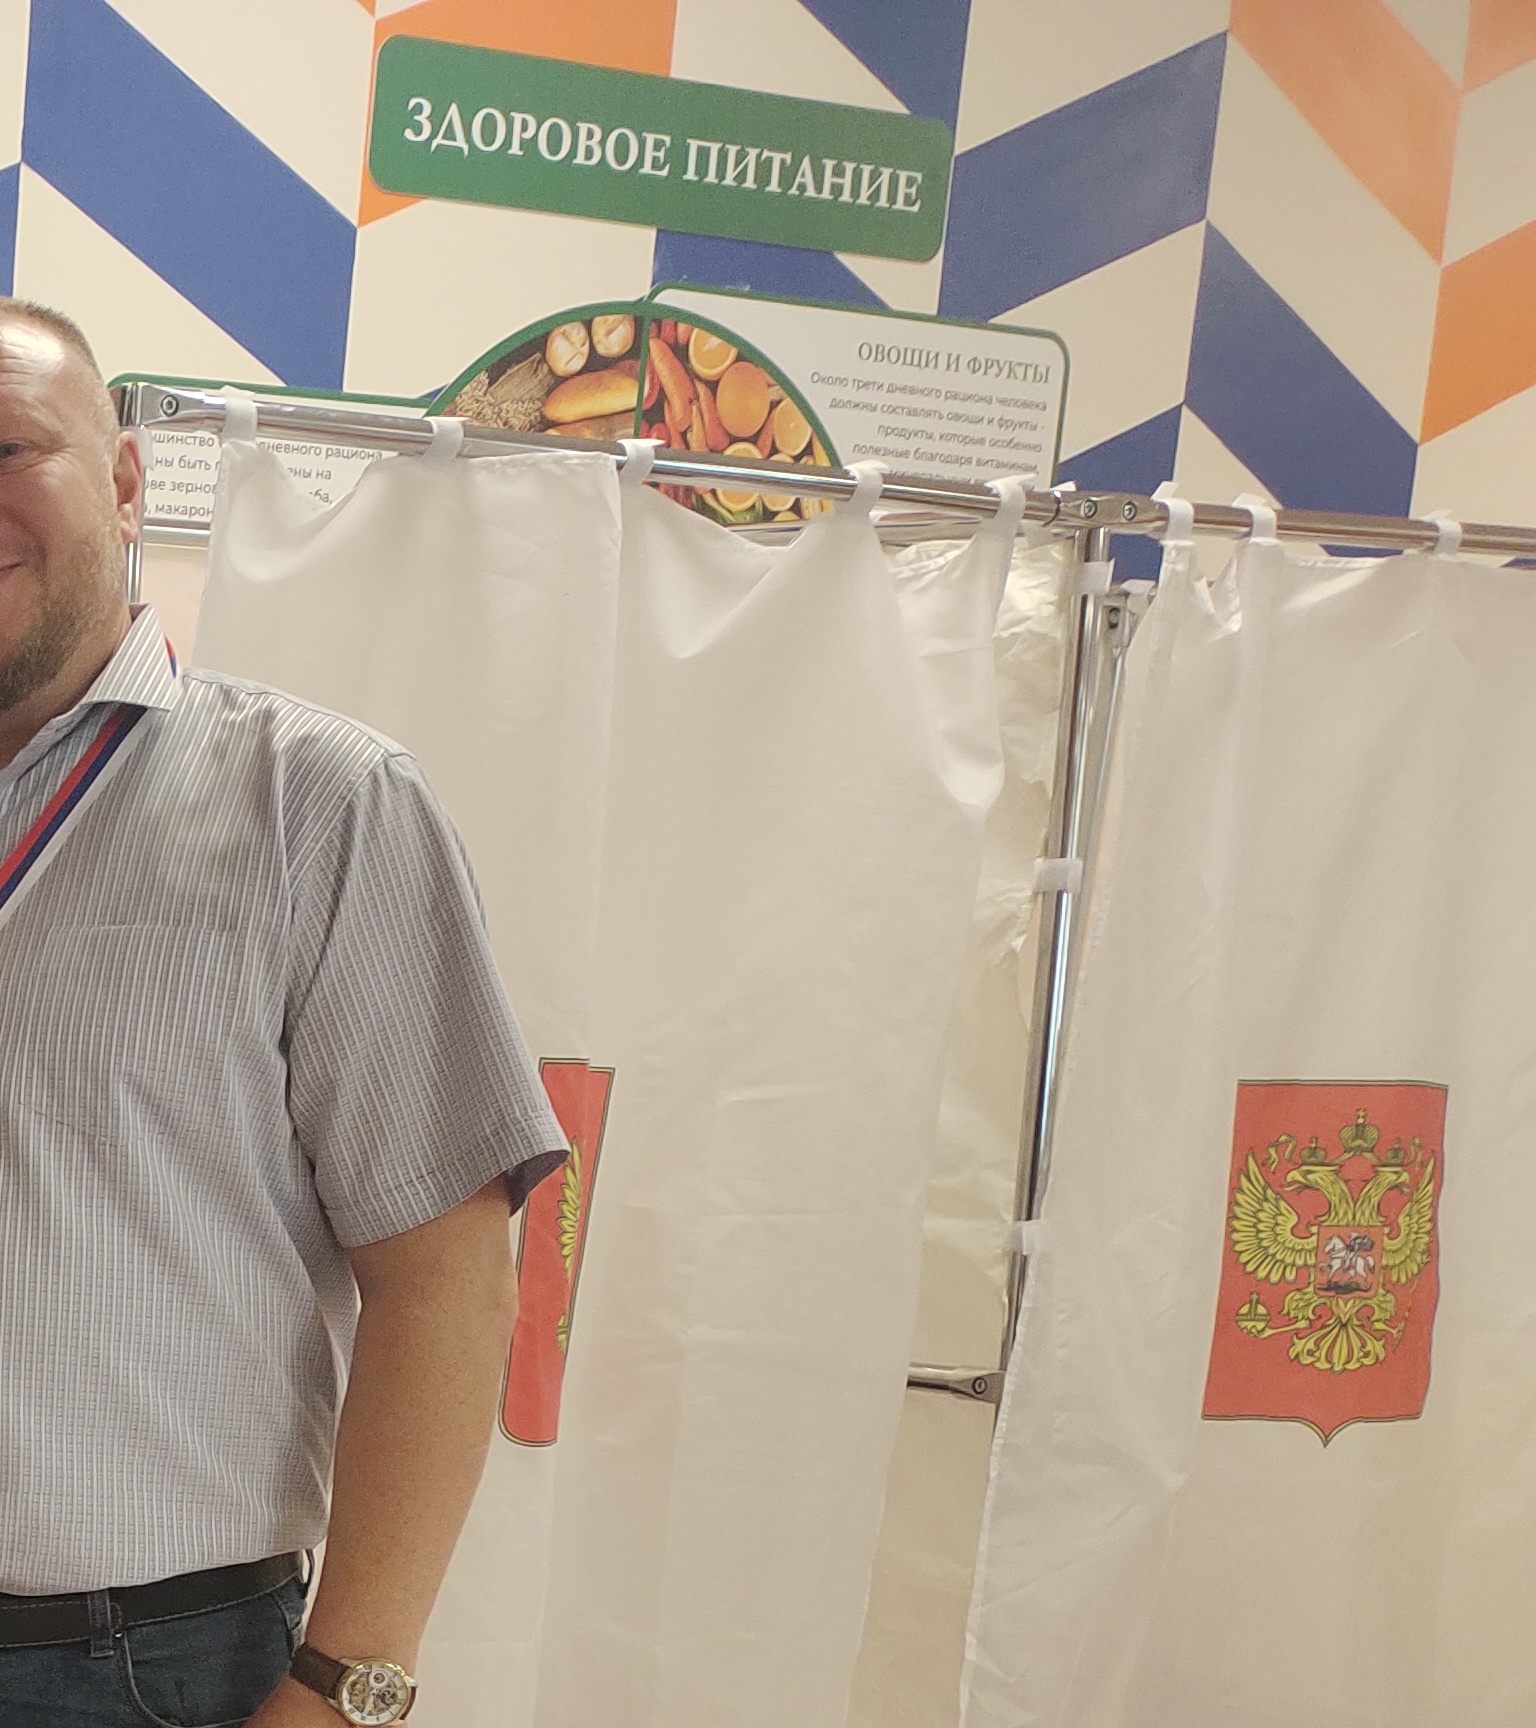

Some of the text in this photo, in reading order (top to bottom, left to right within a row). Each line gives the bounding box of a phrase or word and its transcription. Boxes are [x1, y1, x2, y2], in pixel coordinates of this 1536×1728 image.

[403, 97, 923, 213] ЗДОРОВОЕ ПИТАНИЕ
[858, 341, 1050, 384] ОВОЩИ И ФРУКТЫ
[810, 371, 1047, 412] Около трети дневного рациона человека
[829, 398, 879, 413] должны
[881, 403, 944, 420] составлять
[946, 412, 985, 425] овощи
[987, 417, 995, 426] и
[997, 415, 1039, 432] фрукты
[325, 447, 383, 460] рациона
[877, 424, 1043, 453] продукты, которые особенно
[178, 454, 212, 471] быть
[316, 468, 332, 480] на
[852, 443, 1040, 475] полезные благодаря витаминам,
